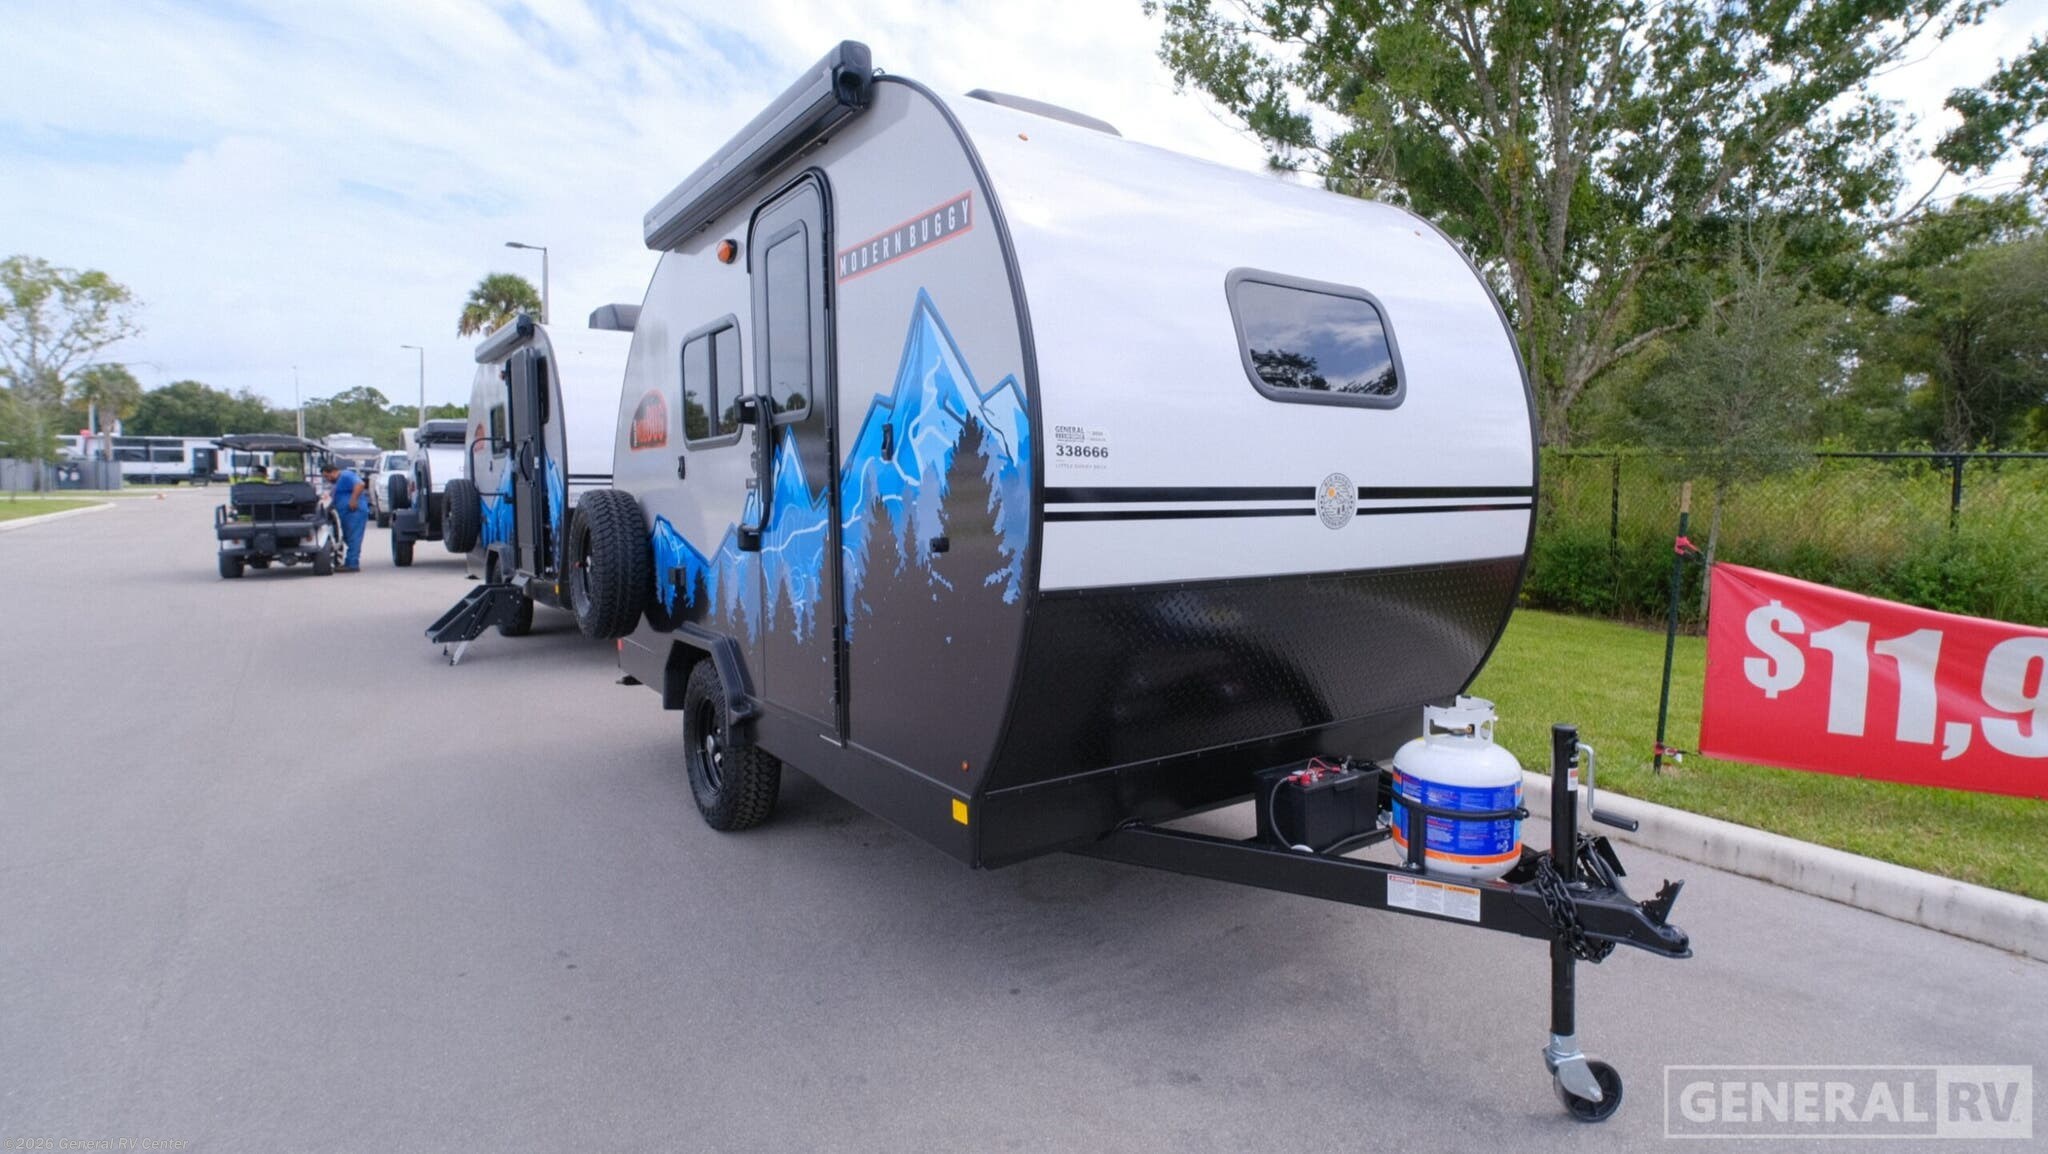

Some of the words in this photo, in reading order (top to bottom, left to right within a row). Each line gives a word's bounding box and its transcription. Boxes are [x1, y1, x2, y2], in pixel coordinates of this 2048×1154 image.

[839, 230, 902, 278] MODERN
[908, 197, 969, 248] BUGGY
[1055, 444, 1109, 459] 338666
